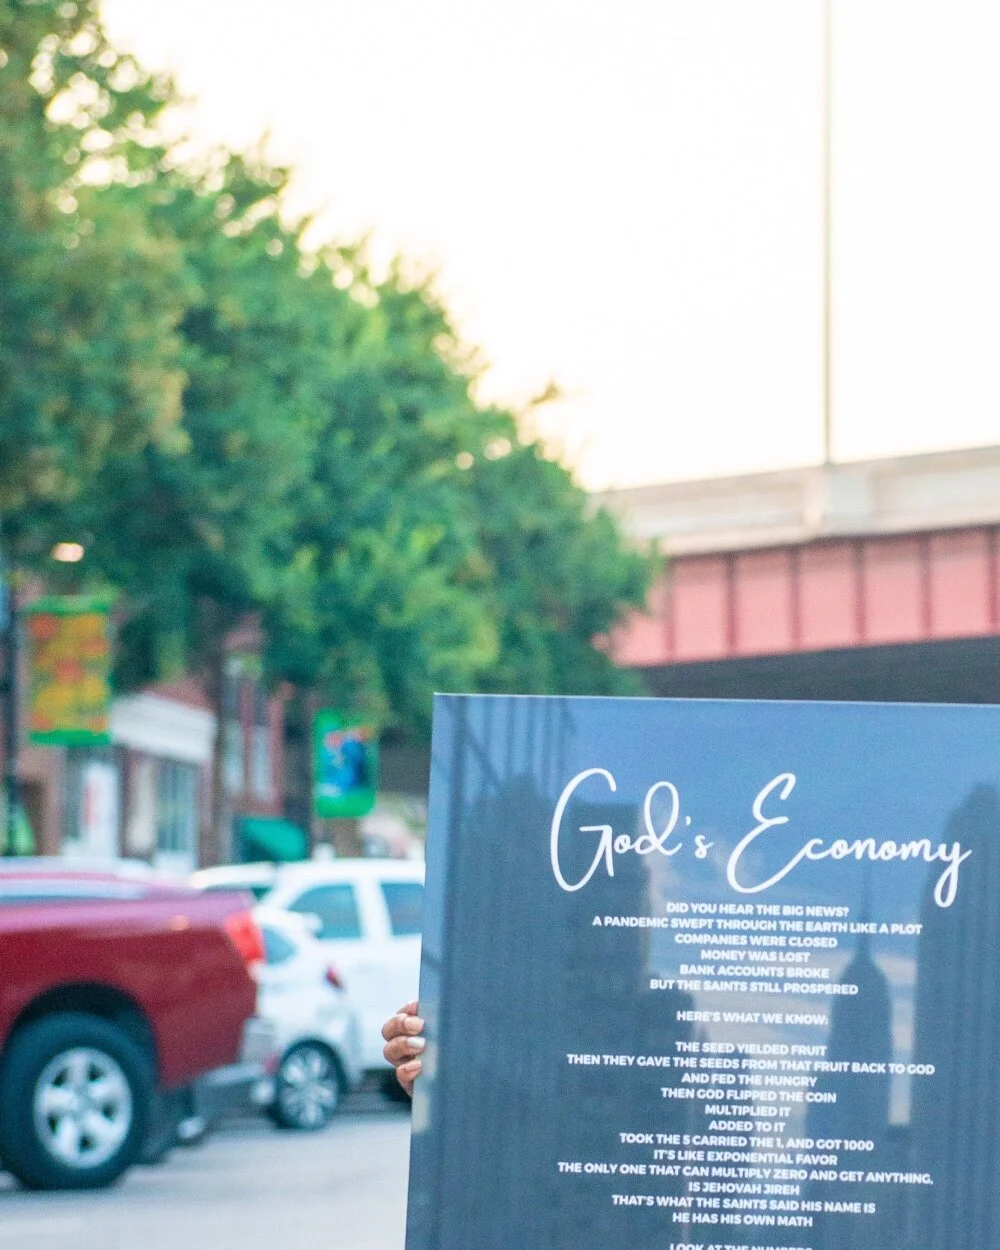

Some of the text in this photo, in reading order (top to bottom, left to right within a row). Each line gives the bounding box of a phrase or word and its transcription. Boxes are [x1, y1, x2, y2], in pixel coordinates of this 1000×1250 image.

[550, 767, 973, 908] God's Economy
[666, 902, 849, 917] DID YOU HEAR THE BIG NEWS?
[592, 916, 923, 934] A PANDEMIC SWEPT THROUGH THE EARTH LIKE A PLOT
[674, 933, 838, 947] COMPANIES WERE CLOSED
[700, 949, 810, 962] MONEY WAS LOST
[679, 964, 829, 978] BANK ACCOUNTS BROKE
[675, 1010, 829, 1024] HERE'S WHAT WE KNOW:
[674, 1041, 827, 1055] THE SEED YIELDED FRUIT
[681, 1072, 818, 1086] AND FED THE HUNGRY
[660, 1087, 836, 1103] THEN GOD FLIPPED THE COIN
[704, 1104, 791, 1117] MULTIPLIED IT
[653, 1149, 838, 1165] IT'S LIKE EXPONENTIAL FAVOR
[688, 1181, 800, 1195] IS JEHOVAH JIREH
[672, 1212, 813, 1226] HE HAS HIS OWN MATH
